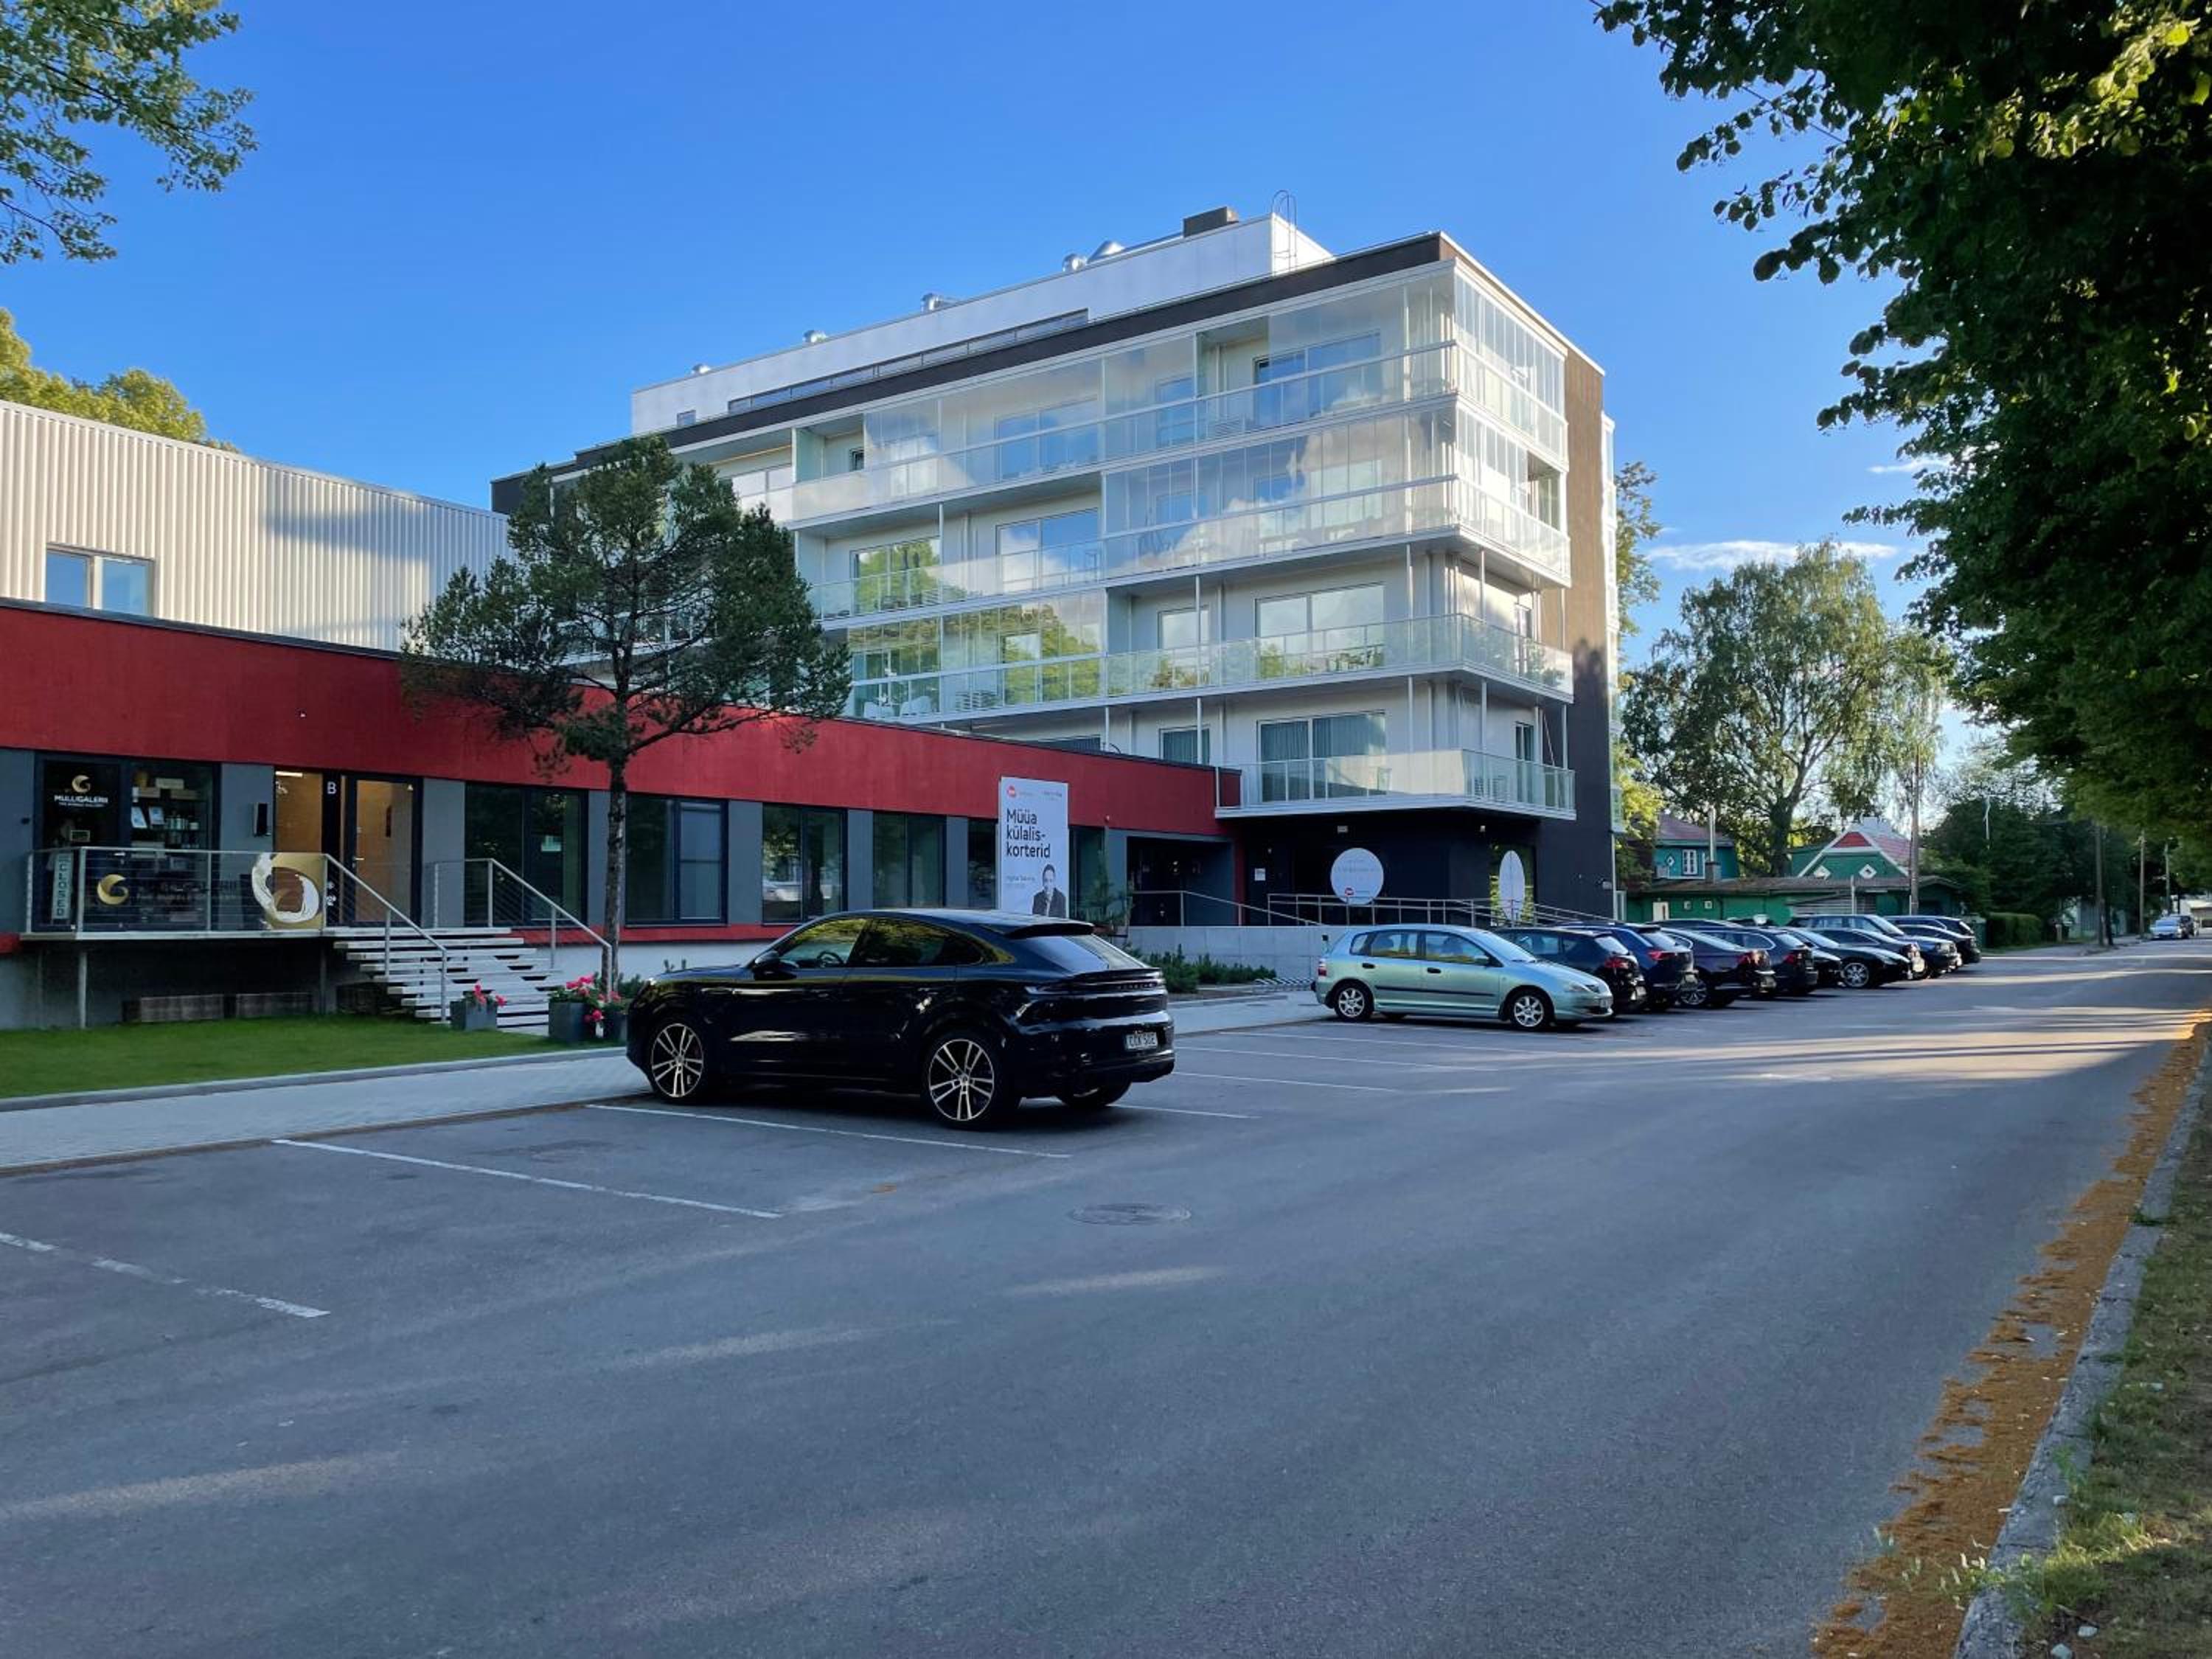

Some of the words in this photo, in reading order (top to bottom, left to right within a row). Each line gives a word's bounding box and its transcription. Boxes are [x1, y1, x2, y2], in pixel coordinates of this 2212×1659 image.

[327, 782, 337, 794] B
[1006, 808, 1037, 824] Müüa
[1006, 825, 1046, 841] külalis-
[1006, 841, 1051, 859] korterid
